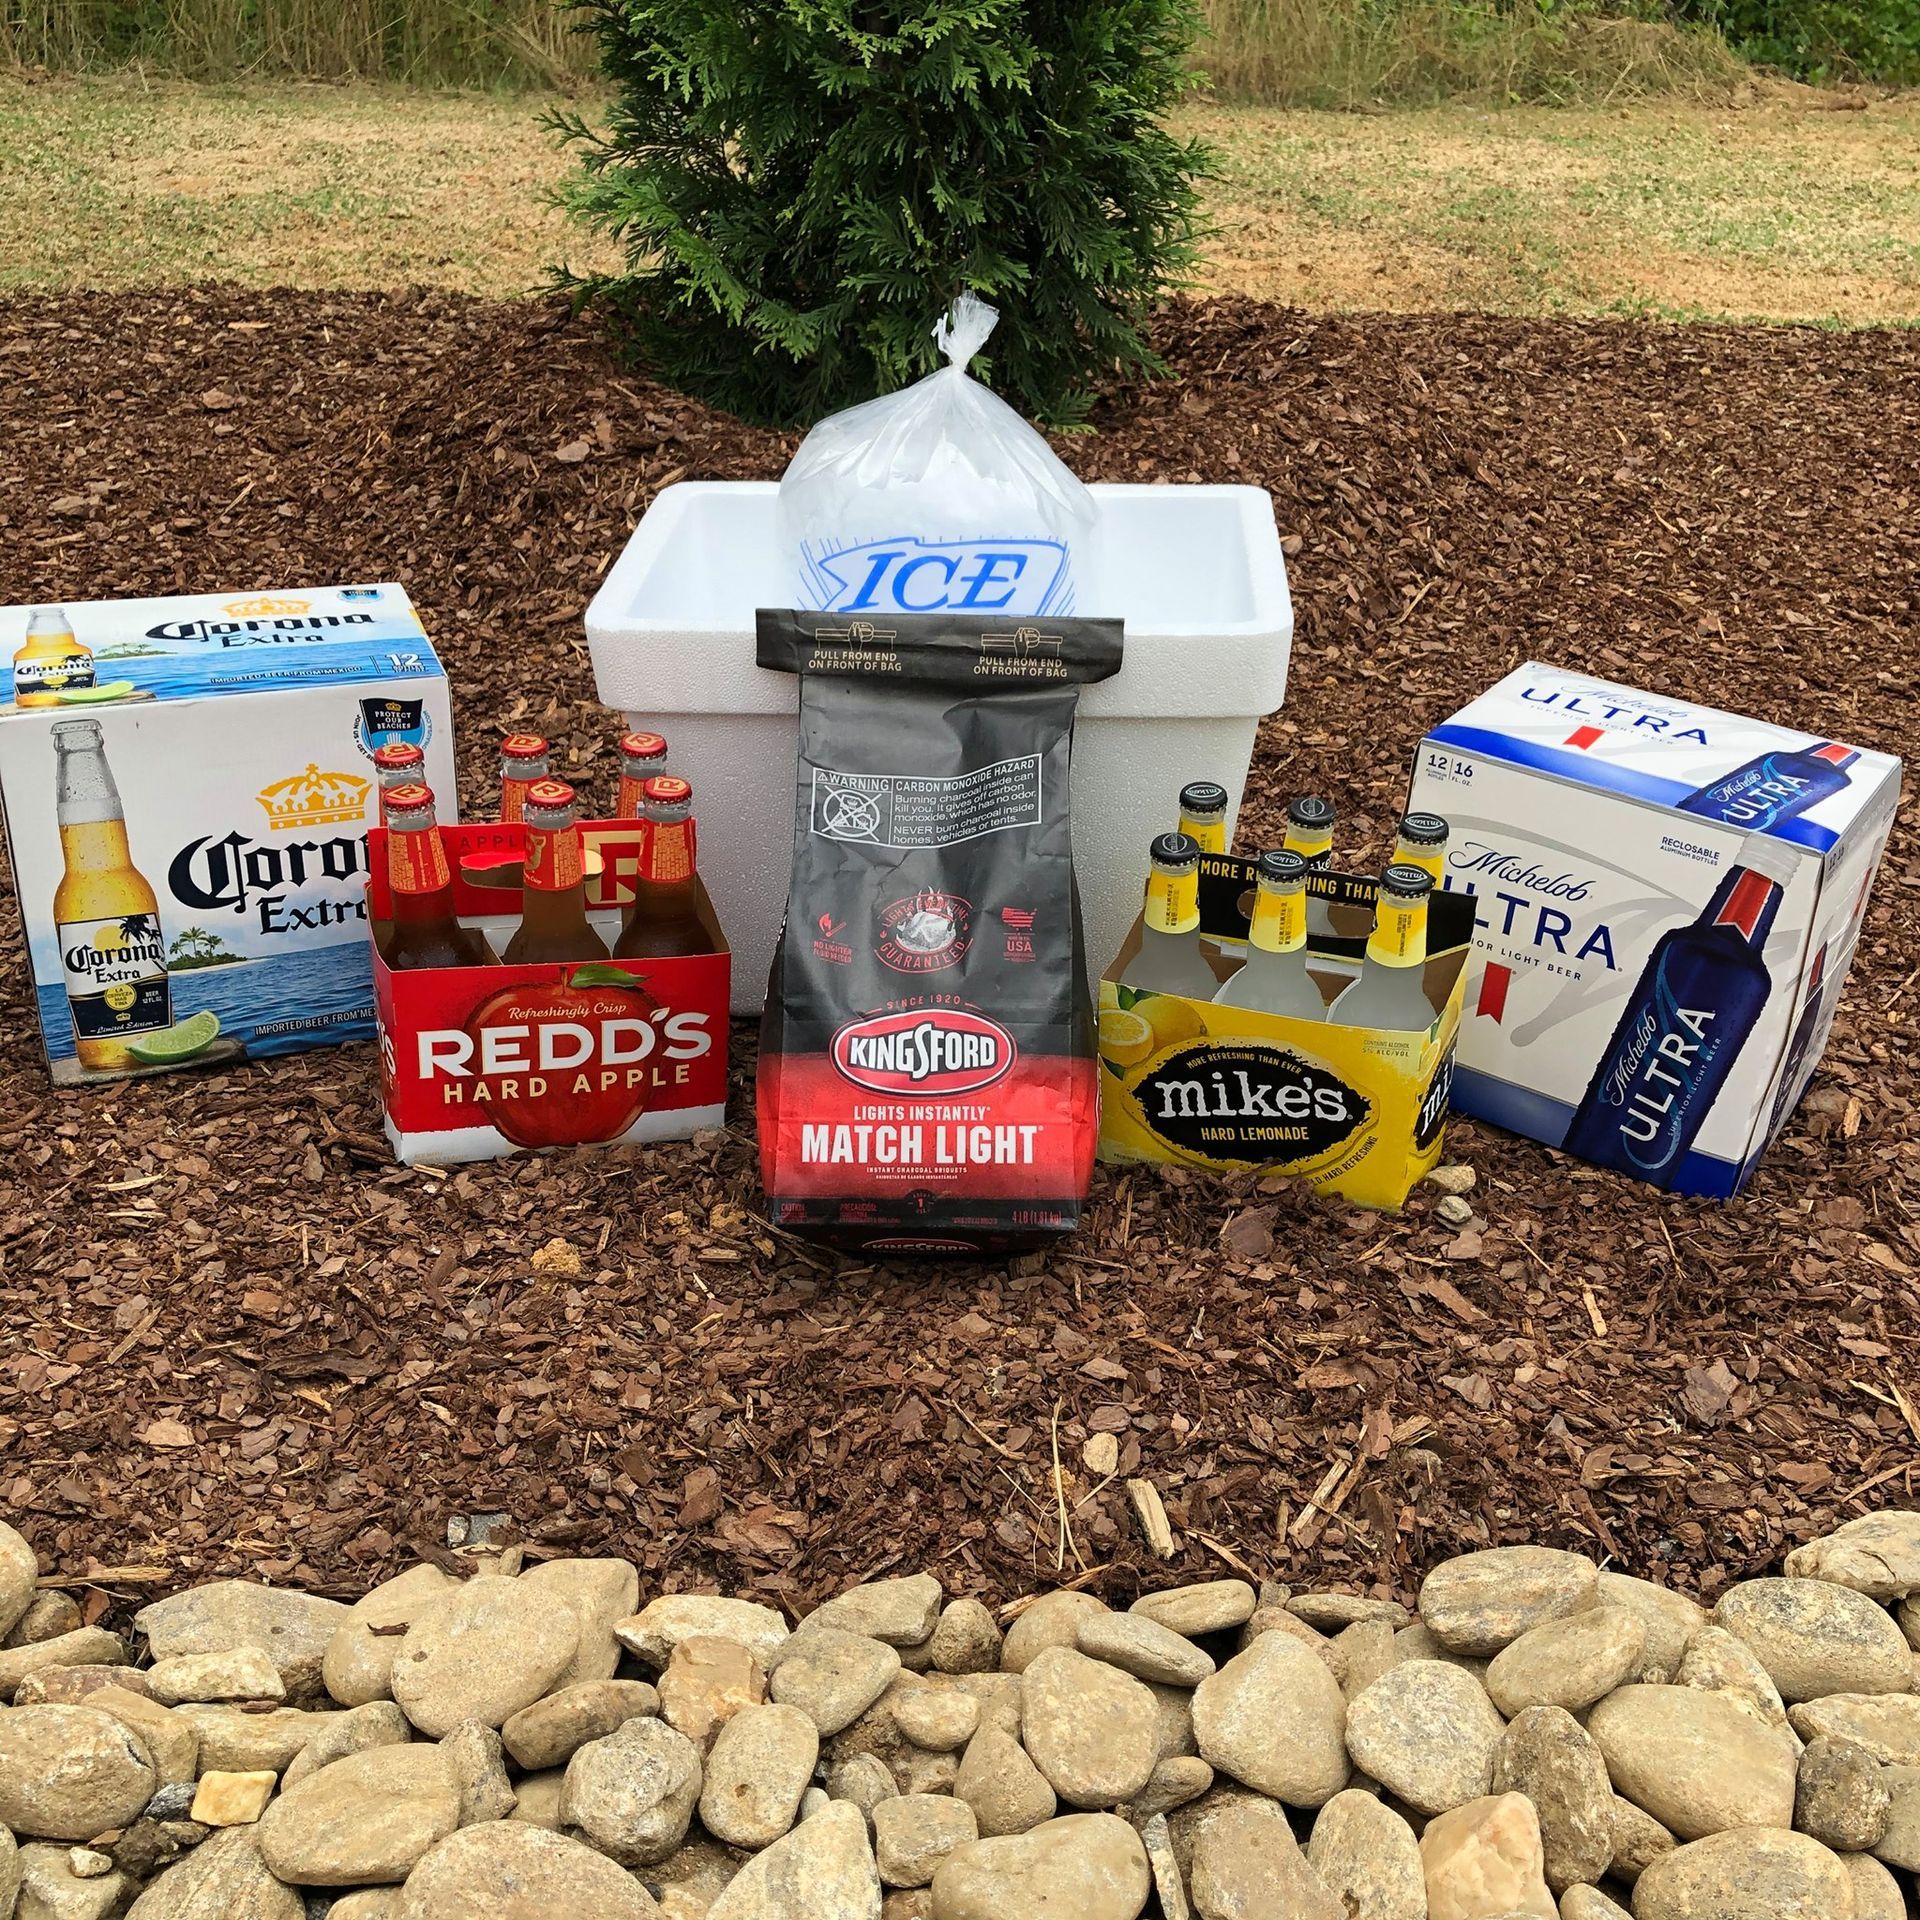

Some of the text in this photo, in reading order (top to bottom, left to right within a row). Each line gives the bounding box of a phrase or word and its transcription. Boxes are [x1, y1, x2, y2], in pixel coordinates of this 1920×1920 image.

[837, 551, 1028, 612] ICE
[145, 608, 374, 642] Corona
[221, 633, 324, 648] Extra
[385, 652, 422, 666] 12
[808, 659, 902, 671] ON FRONT OF BAG
[814, 650, 897, 662] PULL FROM END
[979, 656, 1062, 668] PULL FROM END
[17, 663, 91, 675] Corona
[211, 673, 262, 684] IMPORTED
[264, 671, 293, 680] BEER
[324, 665, 362, 676] MEXICO
[973, 665, 1068, 678] ON FRONT OF BAG
[374, 711, 412, 719] PROTECT
[376, 722, 411, 730] BEACHES
[1520, 687, 1708, 746] ULTRA
[895, 759, 1035, 793] CARBON MONOXIDE HAZARD
[1428, 754, 1473, 778] 12 16
[829, 773, 889, 791] WARNING
[895, 772, 1034, 806] Burning charcoal inside can
[1713, 770, 1762, 803] Michelob
[894, 783, 1025, 815] kill you. It gives off carbon
[894, 790, 1037, 822] monoxide, which has no odor.
[1721, 774, 1810, 820] ULTRA
[893, 802, 1035, 835] NEVER burn charcoal inside
[893, 815, 1018, 845] homes, vehicles or tents.
[1660, 845, 1719, 866] ALUMINUM BOTTLES
[1661, 836, 1721, 860] RECLOSABLE
[1201, 859, 1238, 882] MORE
[1448, 841, 1597, 902] Michelob
[880, 940, 966, 969] GUARANTEED
[1007, 941, 1032, 952] USA
[65, 943, 161, 975] Corona
[1500, 948, 1583, 981] LIGHT BEER
[94, 967, 141, 984] Extra
[508, 1002, 628, 1020] Refreshingly Crisp
[886, 994, 961, 1010] SINCE 1920
[97, 1023, 124, 1034] Limited
[255, 1011, 356, 1036] IMPORTED BEER FROM
[416, 1006, 713, 1080] REDD'S
[850, 1022, 996, 1080] KINGSFORD
[1376, 1049, 1409, 1057] ALC/VOL
[1186, 1051, 1303, 1075] MORE REFRESHING THAN EVER
[1606, 1008, 1657, 1107] Michelob
[443, 1064, 690, 1104] HARD APPLE
[1619, 1007, 1716, 1142] ULTRA
[1154, 1070, 1348, 1122] mike's
[1668, 1038, 1722, 1137] SUPERIOR LIGHT BEER
[854, 1105, 987, 1122] LIGHTS INSTANTLY
[801, 1124, 1038, 1164] MATCH LIGHT
[1201, 1126, 1310, 1141] HARD LEMONADE
[866, 1166, 968, 1174] INSTANT CHARCOAL BRIQUETS
